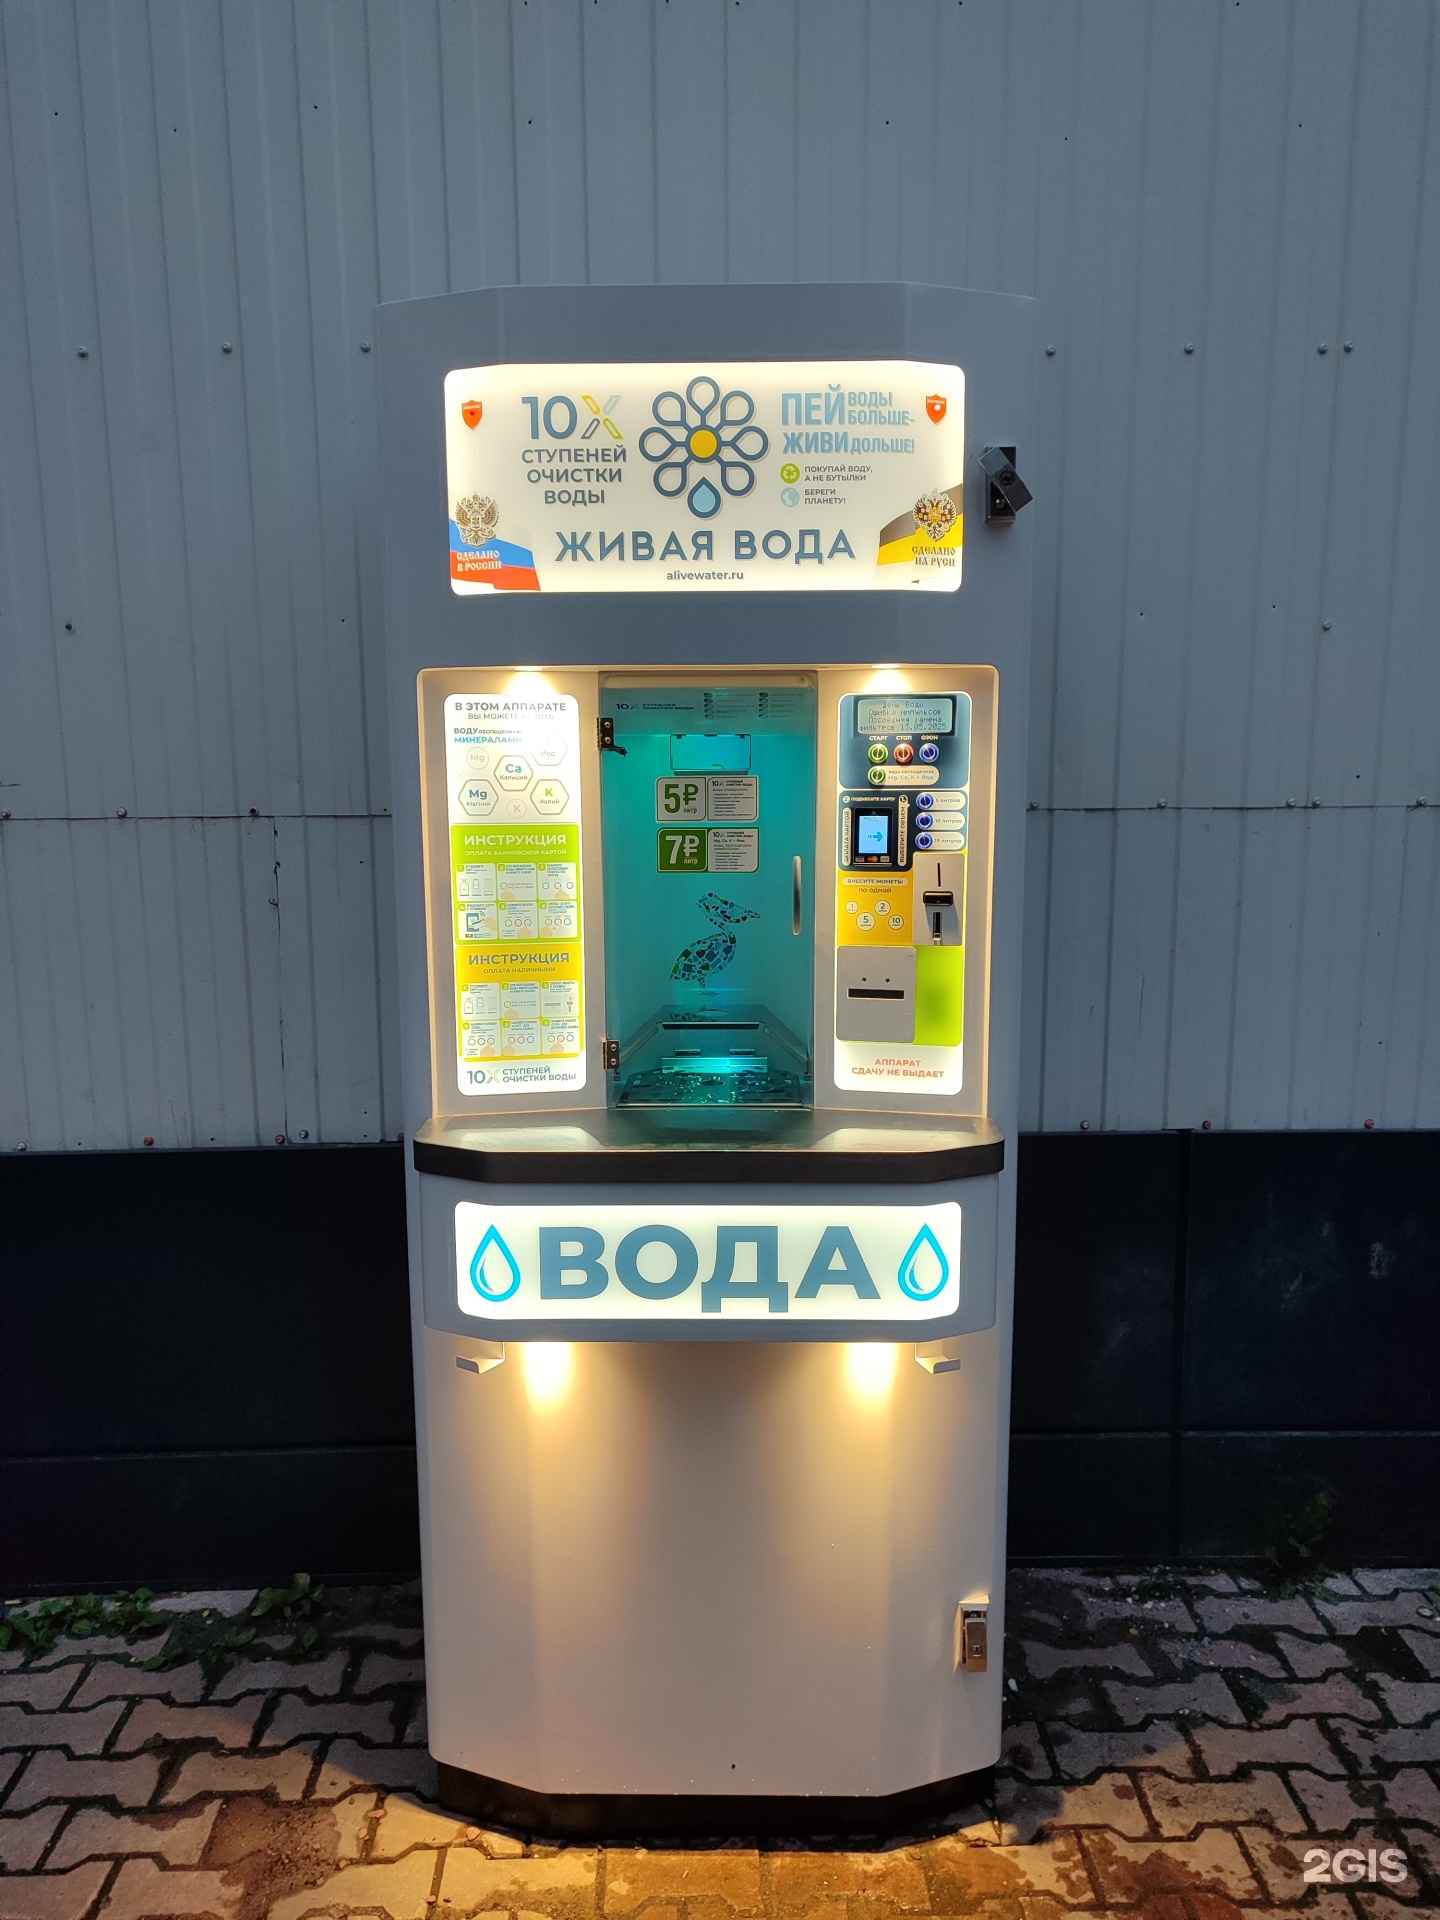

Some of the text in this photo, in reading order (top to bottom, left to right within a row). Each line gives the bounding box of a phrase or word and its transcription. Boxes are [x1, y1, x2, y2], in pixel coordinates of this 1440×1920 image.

[781, 384, 845, 426] ПЕЙ
[848, 392, 893, 408] ВОДЫ
[783, 432, 915, 455] ЖИВИ ДОЛЬШЕ!
[521, 445, 627, 463] СТУПЕНЕЙ
[804, 463, 873, 474] ПОКУПАЙ ВОДУ,
[527, 468, 622, 484] ОЧИСТКИ
[804, 474, 867, 482] А НЕ БУТЫЛКИ
[544, 489, 605, 506] ВОДЫ
[804, 488, 836, 496] БЕРЕГИ
[804, 497, 846, 505] ПЛАНЕТУ!
[555, 529, 856, 564] ЖИВАЯ ВОДА
[666, 570, 744, 581] alivewater.ru
[455, 702, 567, 711] В ЭТОМ АППАРАТЕ
[468, 712, 480, 720] ВЫ
[505, 763, 522, 774] Ca
[469, 789, 488, 800] Mg
[464, 834, 567, 846] ИНСТРУКЦИЯ
[468, 953, 569, 966] ИНСТРУКЦИЯ
[875, 1058, 921, 1067] АППАРАТ
[502, 1065, 551, 1075] СТУПЕНЕЙ
[852, 1067, 944, 1078] СДАЧУ НЕ ВЫДАЕТ
[502, 1074, 546, 1084] ОЧИСТКИ
[539, 1224, 881, 1313] ВОДА
